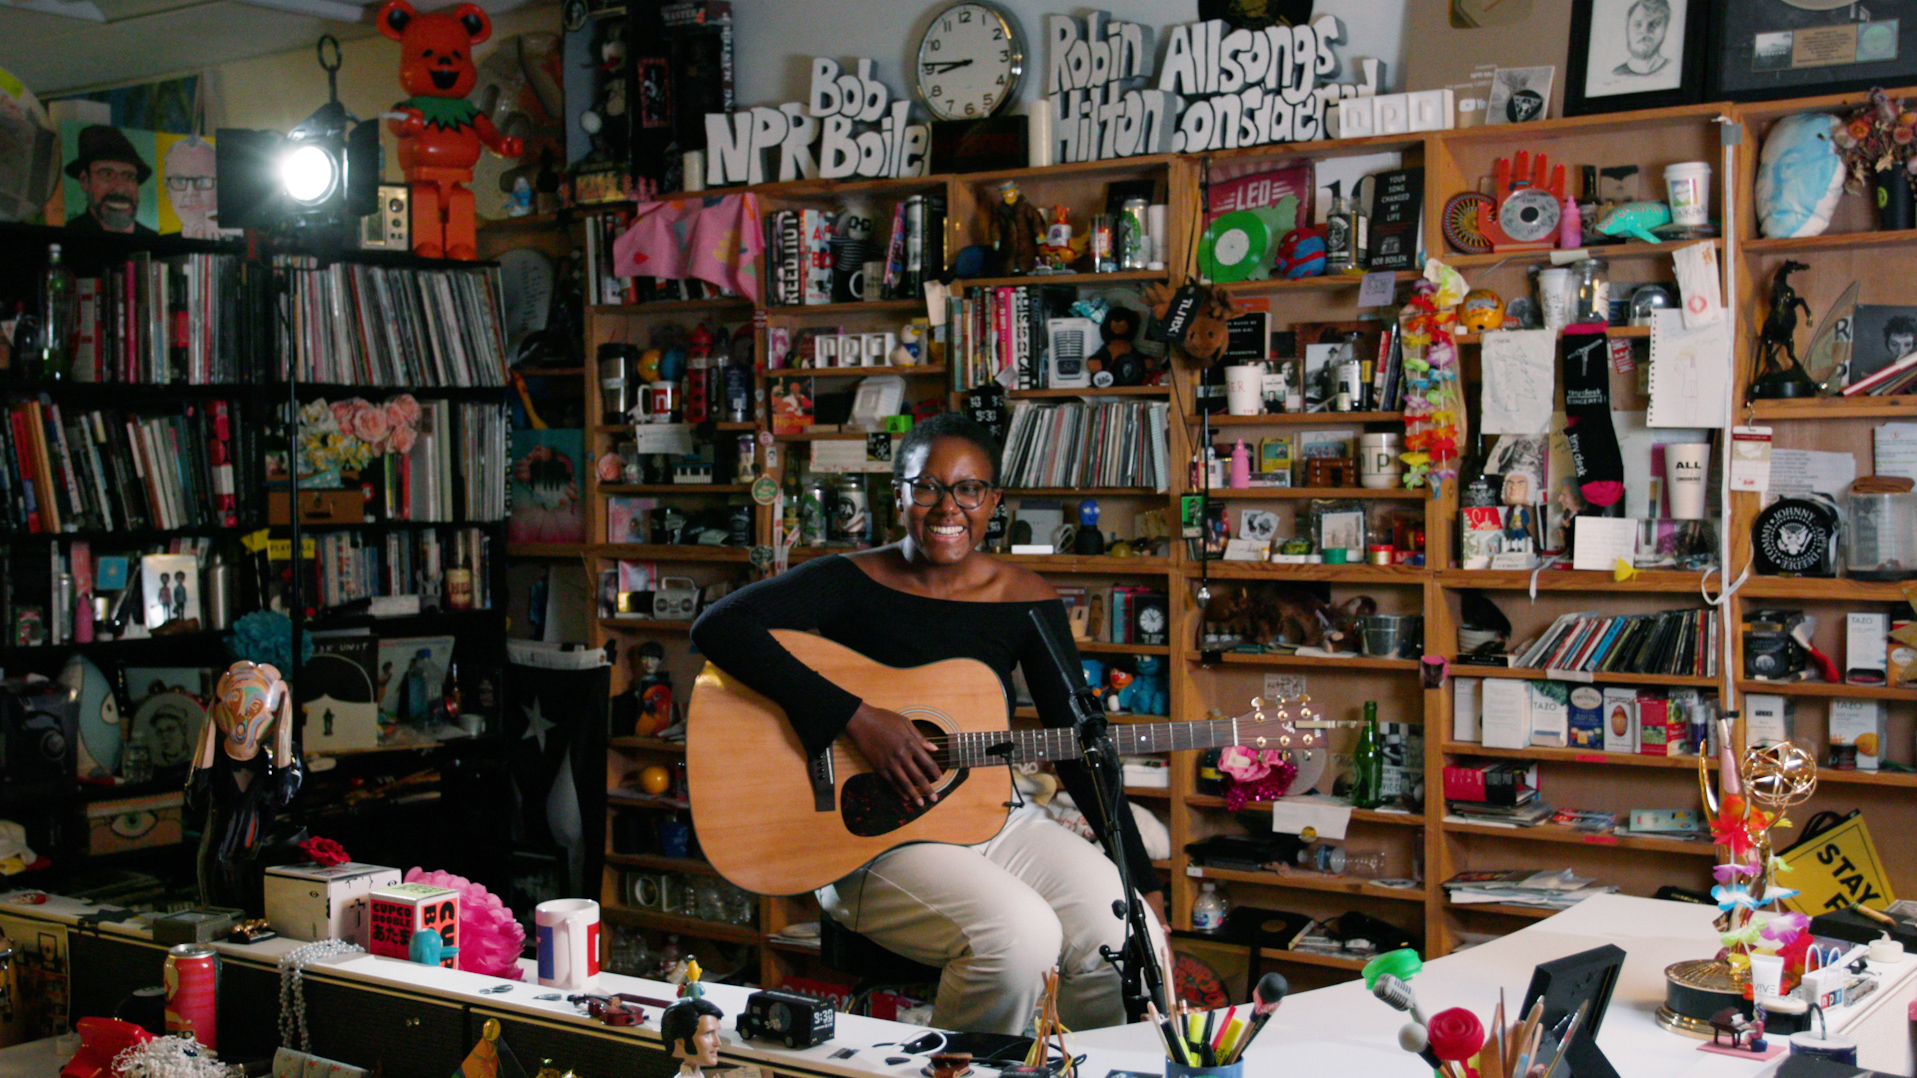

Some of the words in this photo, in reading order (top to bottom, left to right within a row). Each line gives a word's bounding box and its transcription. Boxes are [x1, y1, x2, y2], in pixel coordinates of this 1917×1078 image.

[1049, 11, 1144, 94] Robin
[1158, 14, 1341, 105] Allsongs
[809, 57, 887, 121] Bob
[1346, 99, 1434, 128] npr
[1049, 82, 1165, 164] Hilton
[705, 102, 820, 185] NPR
[1389, 174, 1407, 184] YOUR
[1235, 181, 1271, 211] LED
[1388, 184, 1406, 193] SONG
[1380, 193, 1410, 204] CHANGED
[1390, 203, 1399, 212] MY
[1386, 211, 1401, 222] LIFE
[1371, 255, 1384, 266] BOB
[1384, 254, 1408, 265] BOILEN
[1569, 432, 1581, 455] tiny
[1573, 451, 1586, 478] desk
[1675, 461, 1702, 470] ALL
[1771, 506, 1814, 526] JOHNNY
[1760, 526, 1782, 564] TOMMY
[1851, 616, 1873, 625] TAZO
[1532, 700, 1557, 711] TAZO
[1836, 700, 1863, 710] TAZO
[1817, 843, 1881, 907] STAY
[372, 902, 412, 918] CUPCO
[372, 913, 411, 928] BOOBLE
[372, 924, 411, 946] あたま
[1753, 983, 1777, 995] VIVE
[1821, 989, 1843, 1009] npr
[813, 1008, 834, 1025] 9:30
